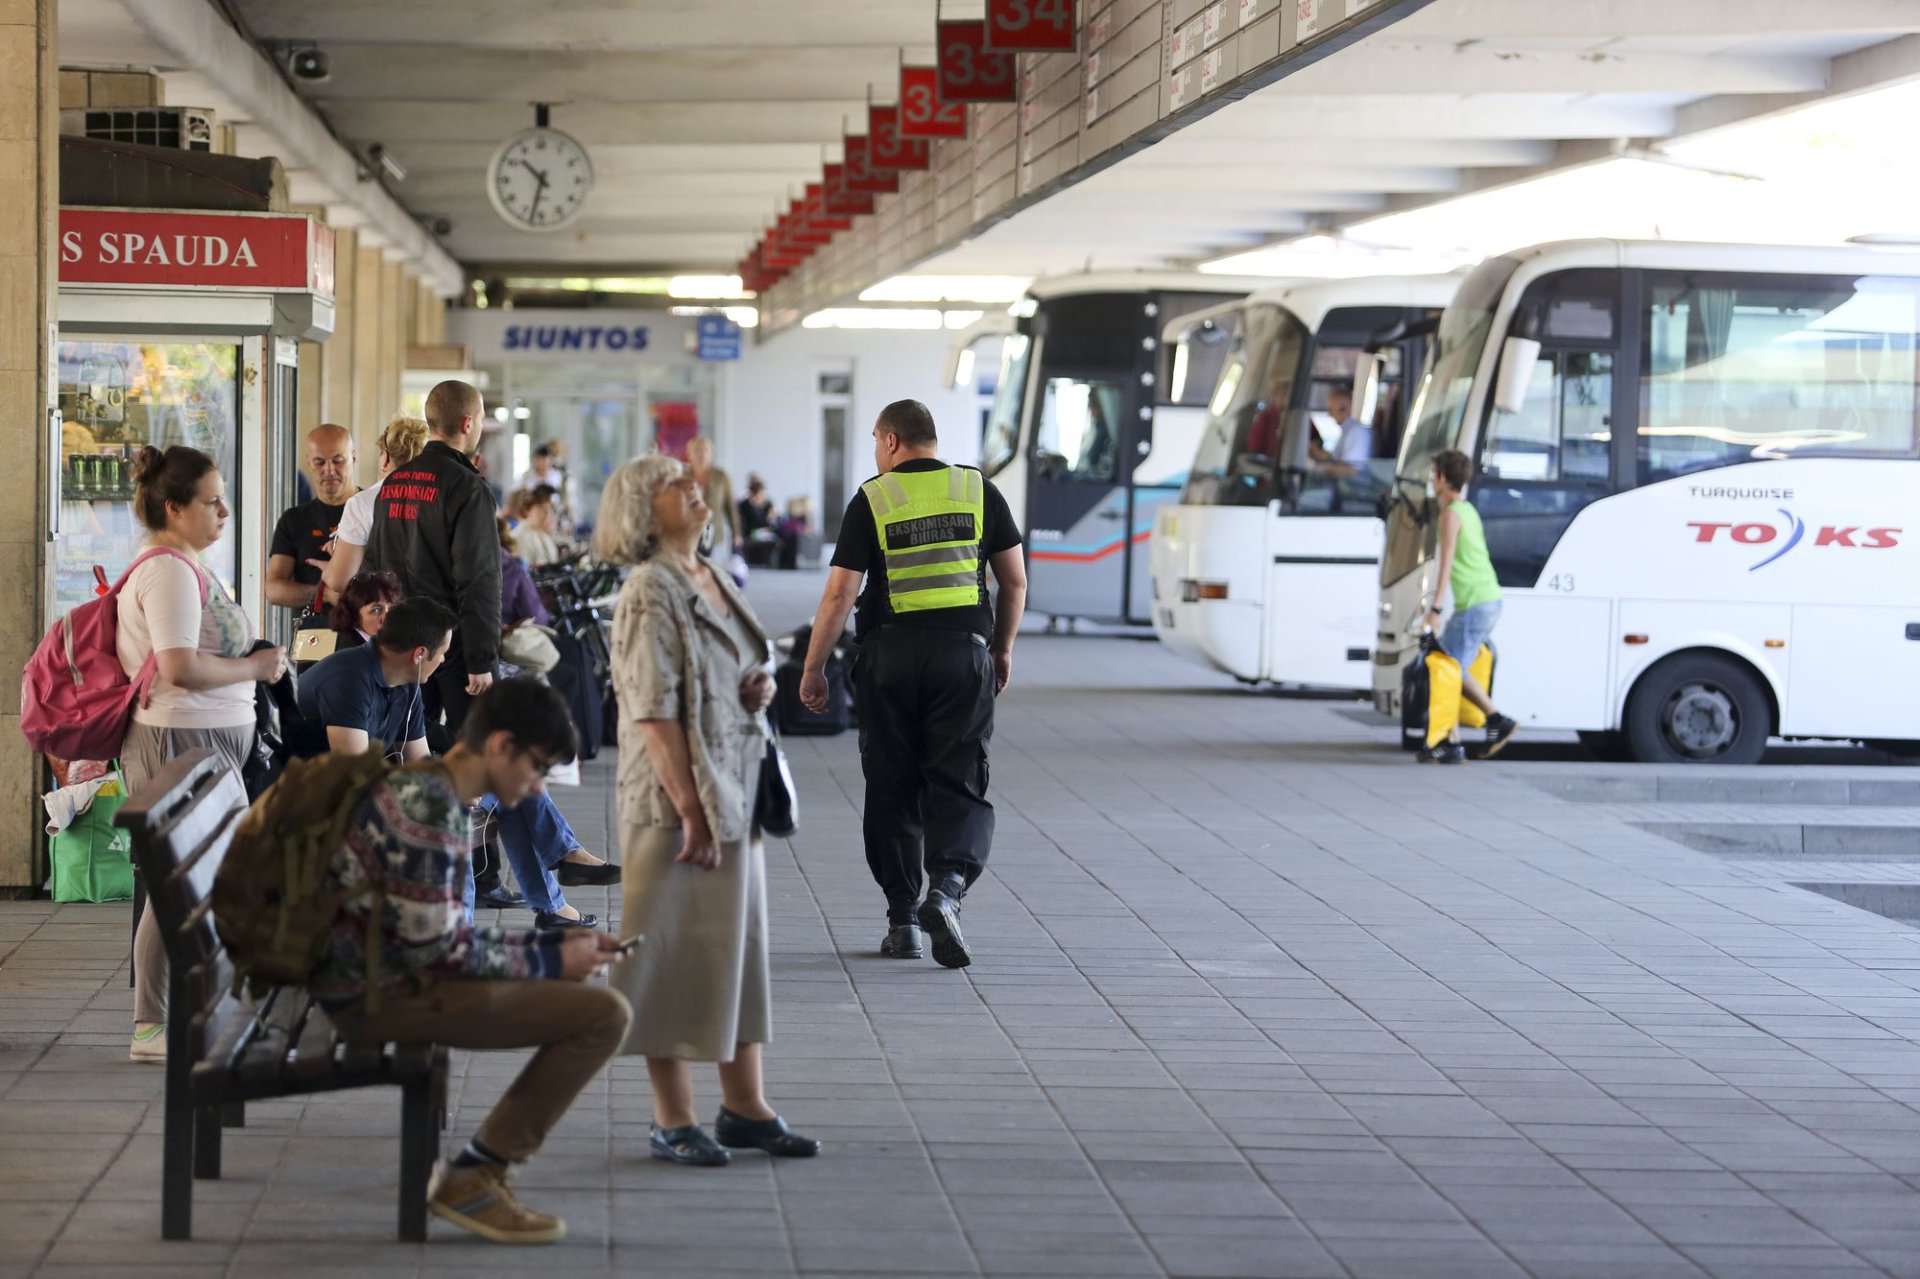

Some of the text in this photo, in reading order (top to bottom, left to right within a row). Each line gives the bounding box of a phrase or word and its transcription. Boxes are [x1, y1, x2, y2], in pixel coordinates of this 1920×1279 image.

[996, 0, 1069, 31] 34
[945, 43, 1007, 85] 33
[905, 84, 961, 123] 32
[99, 232, 258, 268] SPAUDA
[503, 325, 650, 350] SIUNTOS
[1689, 486, 1794, 500] TURQUOISE
[910, 527, 955, 545] BIURAS
[1548, 573, 1576, 592] 43
